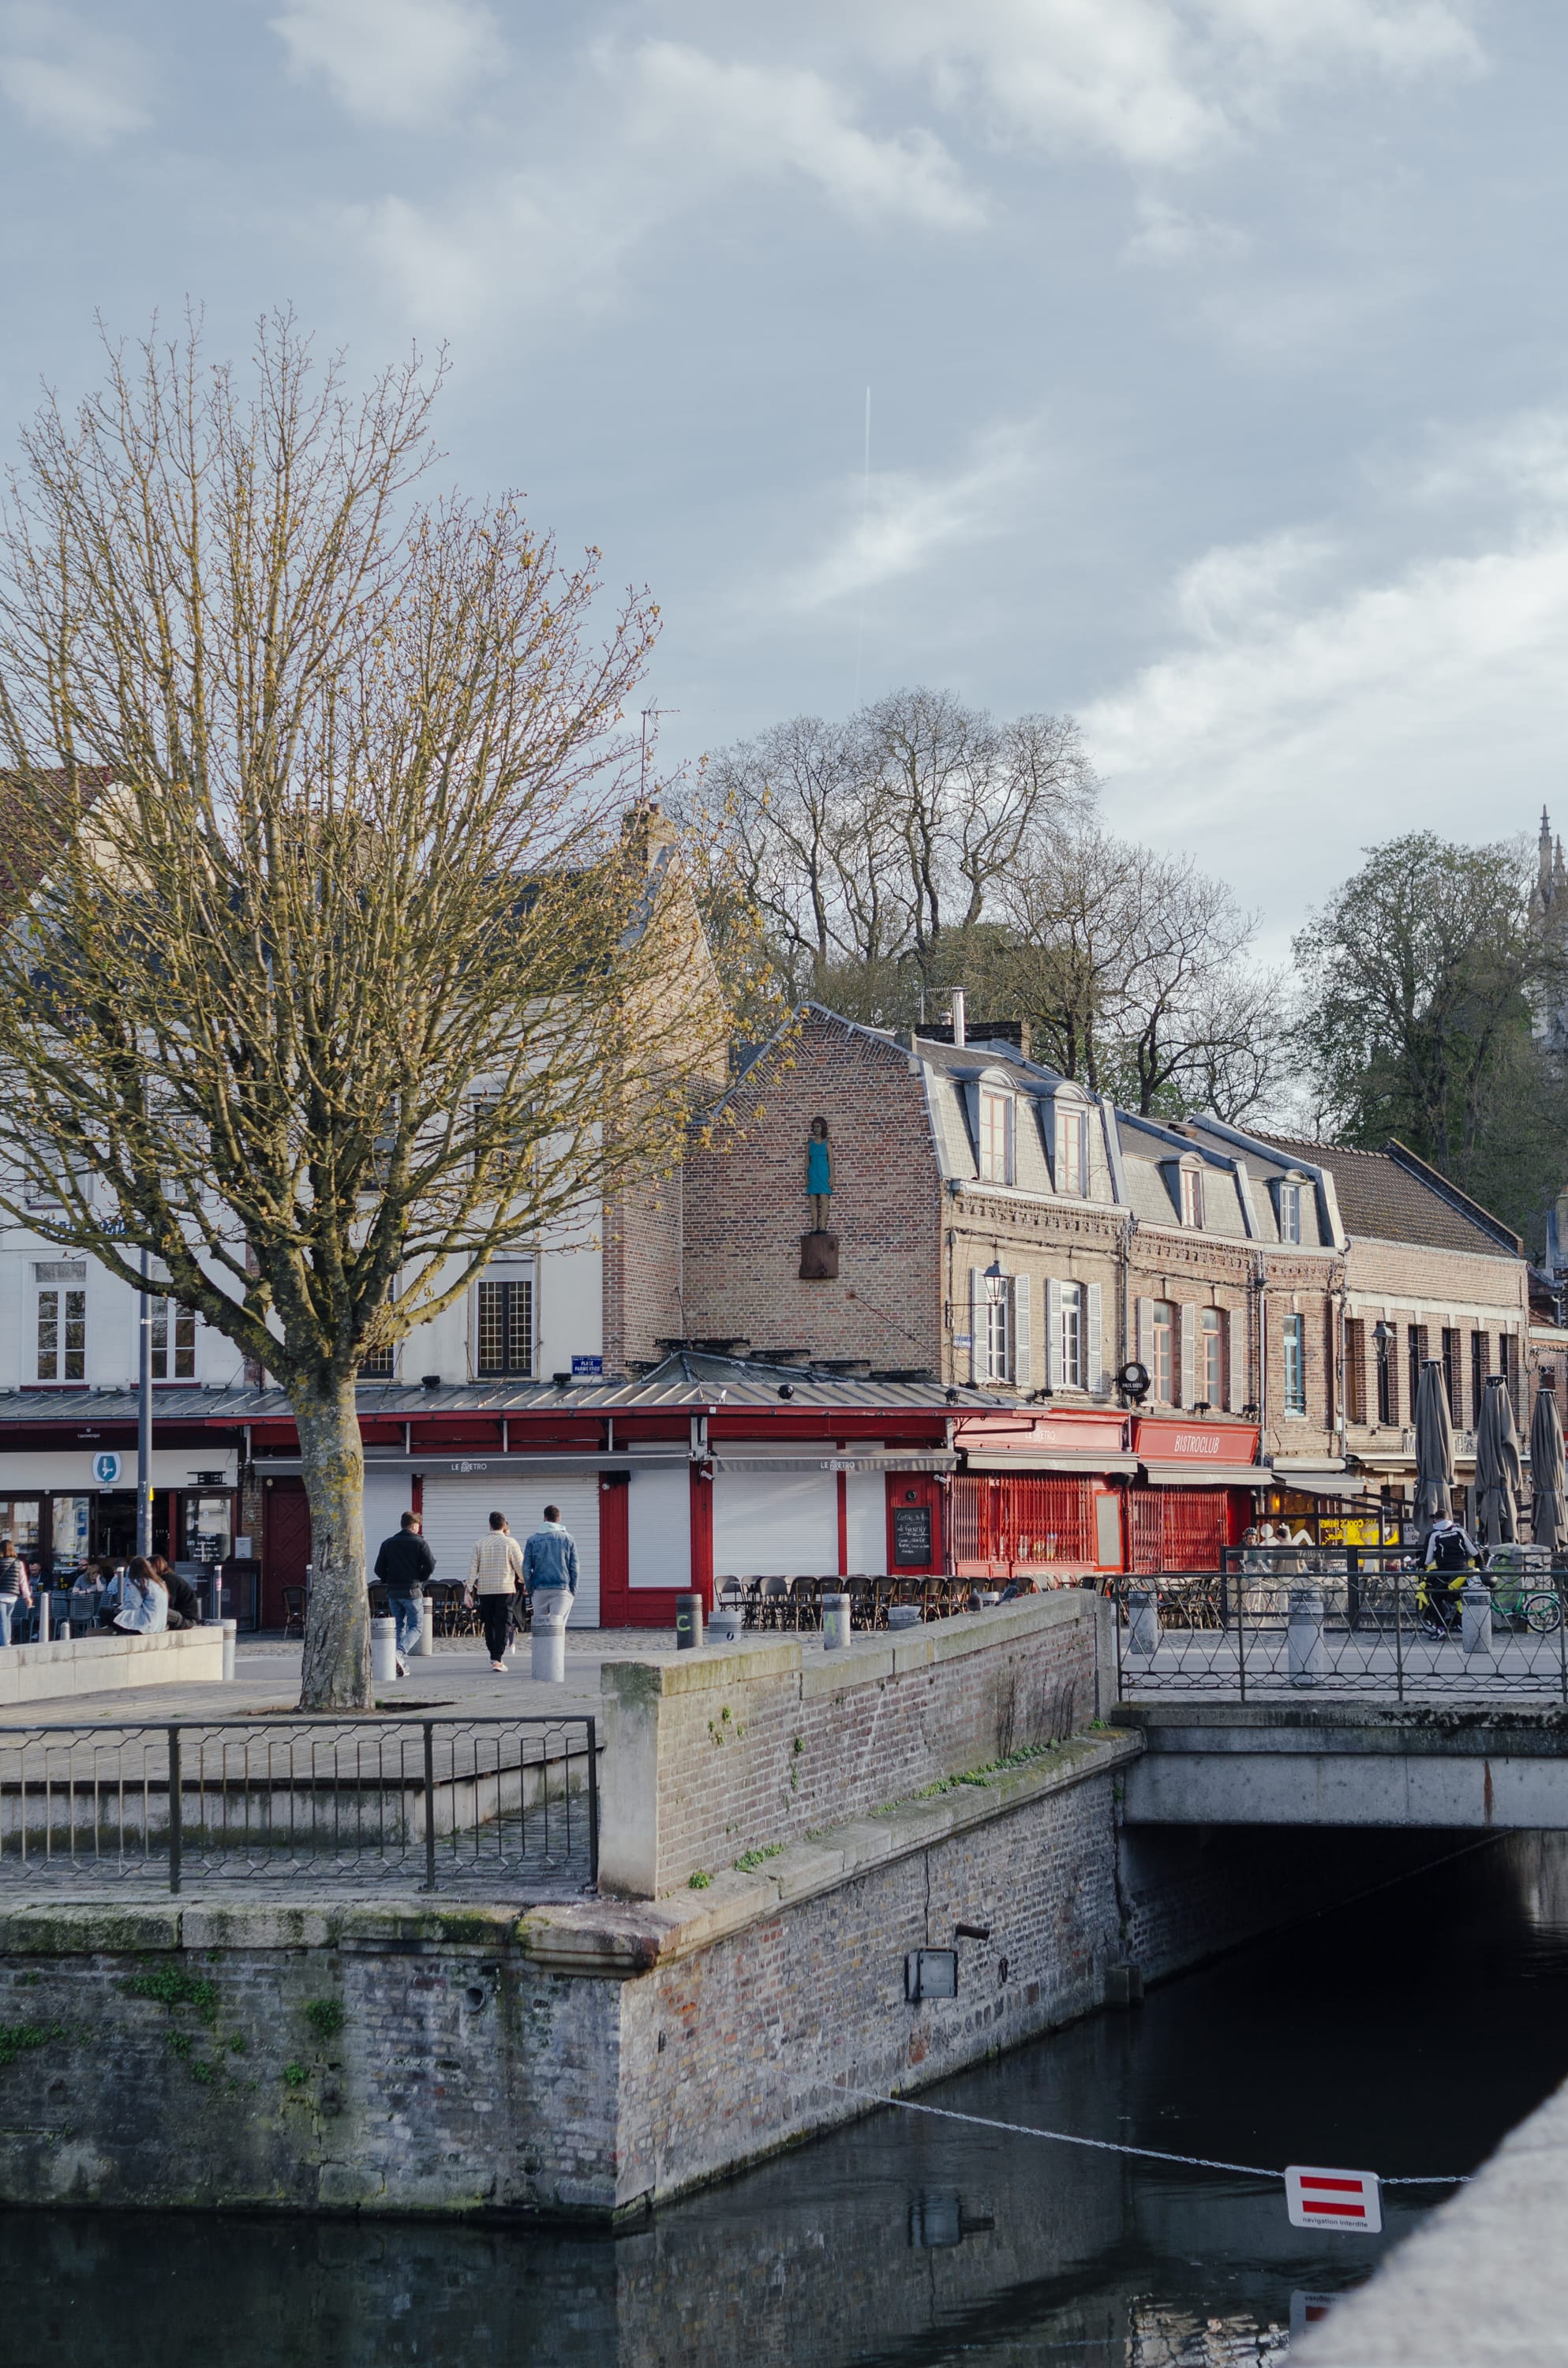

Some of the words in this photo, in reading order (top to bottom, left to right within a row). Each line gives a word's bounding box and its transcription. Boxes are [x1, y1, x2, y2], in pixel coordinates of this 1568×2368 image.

[1174, 1435, 1220, 1453] BISTROCLUB
[676, 1615, 691, 1632] C
[1302, 2216, 1338, 2226] navigation
[1339, 2219, 1368, 2228] interdite
